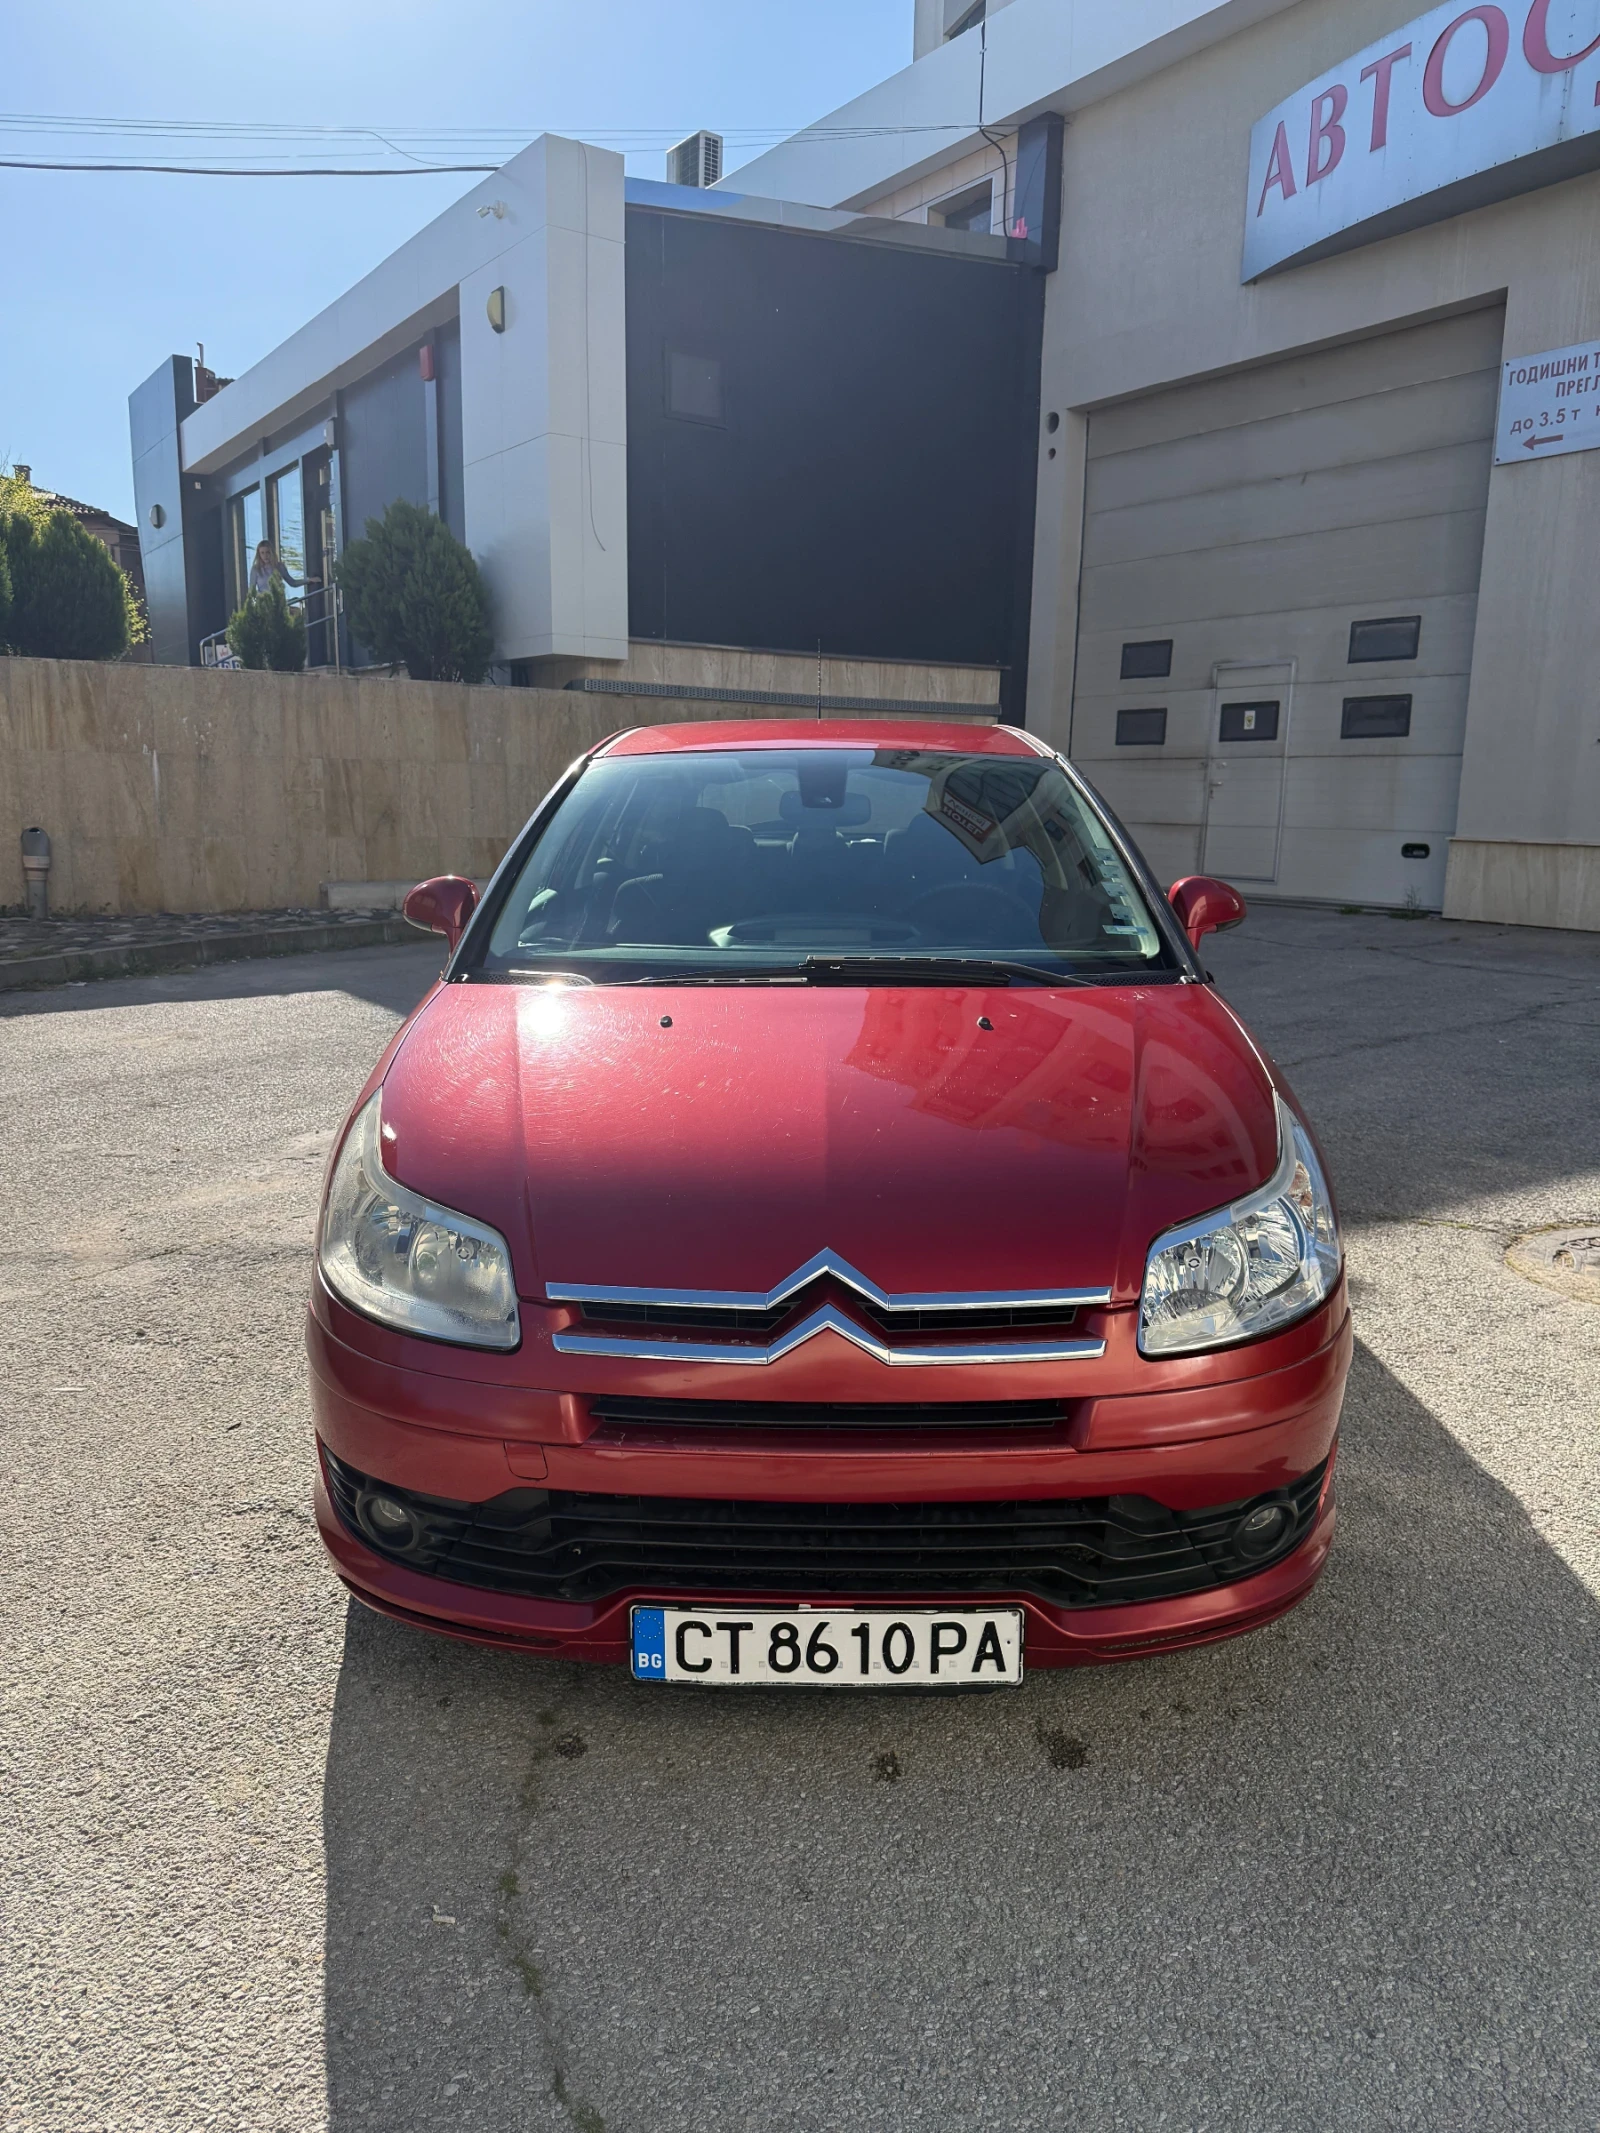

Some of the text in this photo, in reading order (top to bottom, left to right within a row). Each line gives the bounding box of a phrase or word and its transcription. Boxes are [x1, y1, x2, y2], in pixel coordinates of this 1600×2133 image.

[1508, 354, 1589, 386] ГОДИШНИ
[1510, 418, 1533, 435] до
[1539, 408, 1566, 427] 3.5
[638, 1652, 662, 1669] BG
